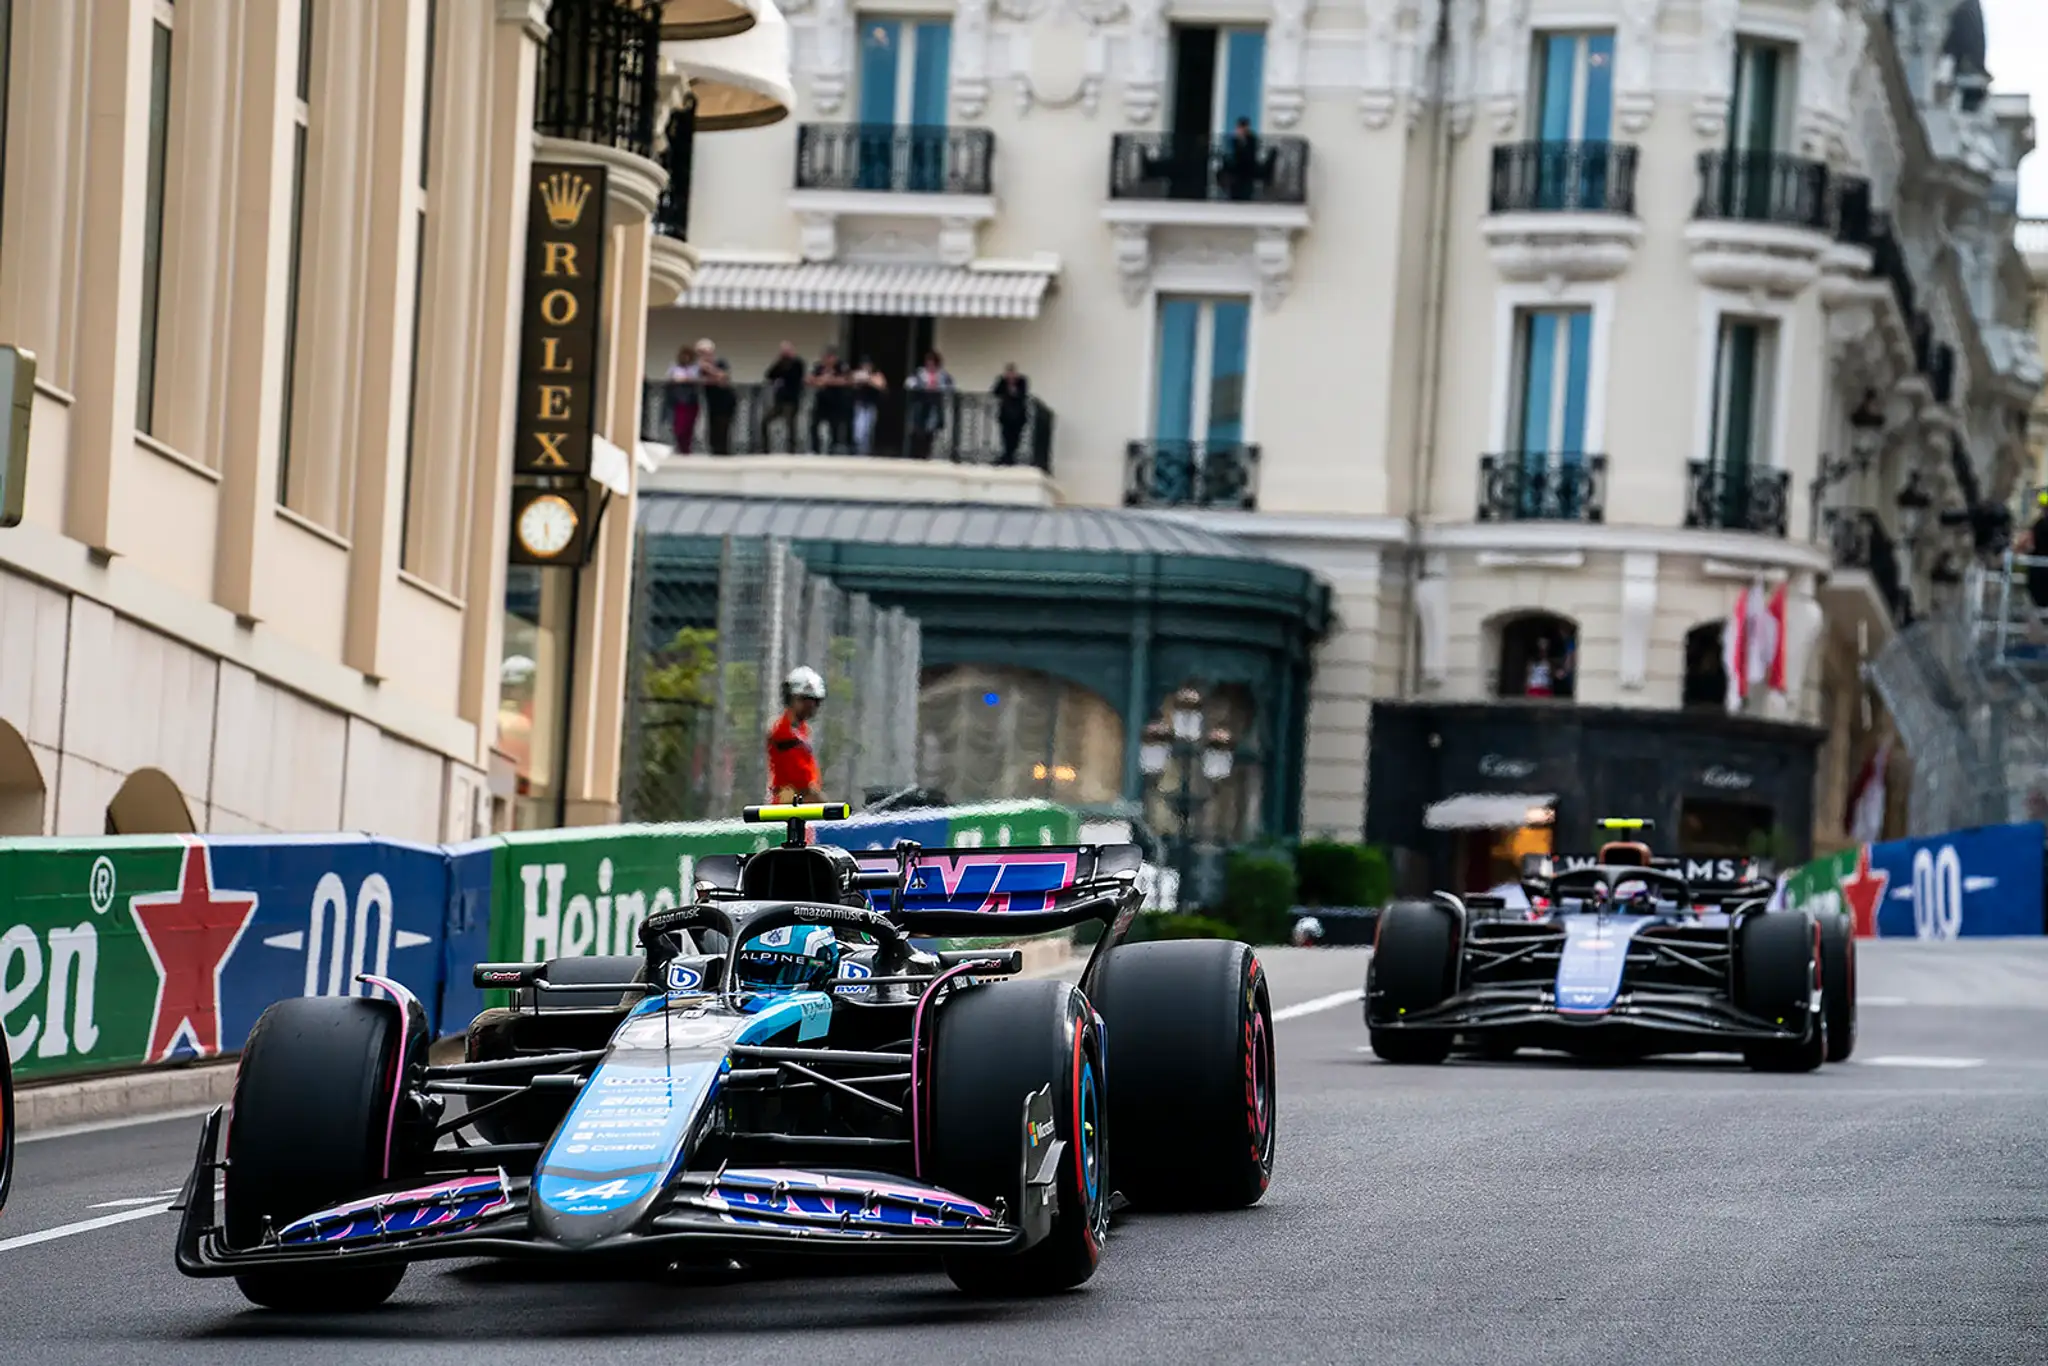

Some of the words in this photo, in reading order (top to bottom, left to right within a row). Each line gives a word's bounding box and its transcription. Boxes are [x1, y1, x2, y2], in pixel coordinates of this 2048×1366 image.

[532, 241, 580, 467] ROLEX
[675, 906, 701, 920] music
[793, 906, 832, 918] amazon
[833, 909, 865, 921] music
[740, 952, 806, 965] ALPINE
[833, 984, 870, 994] BWT
[590, 1143, 657, 1152] Castrol
